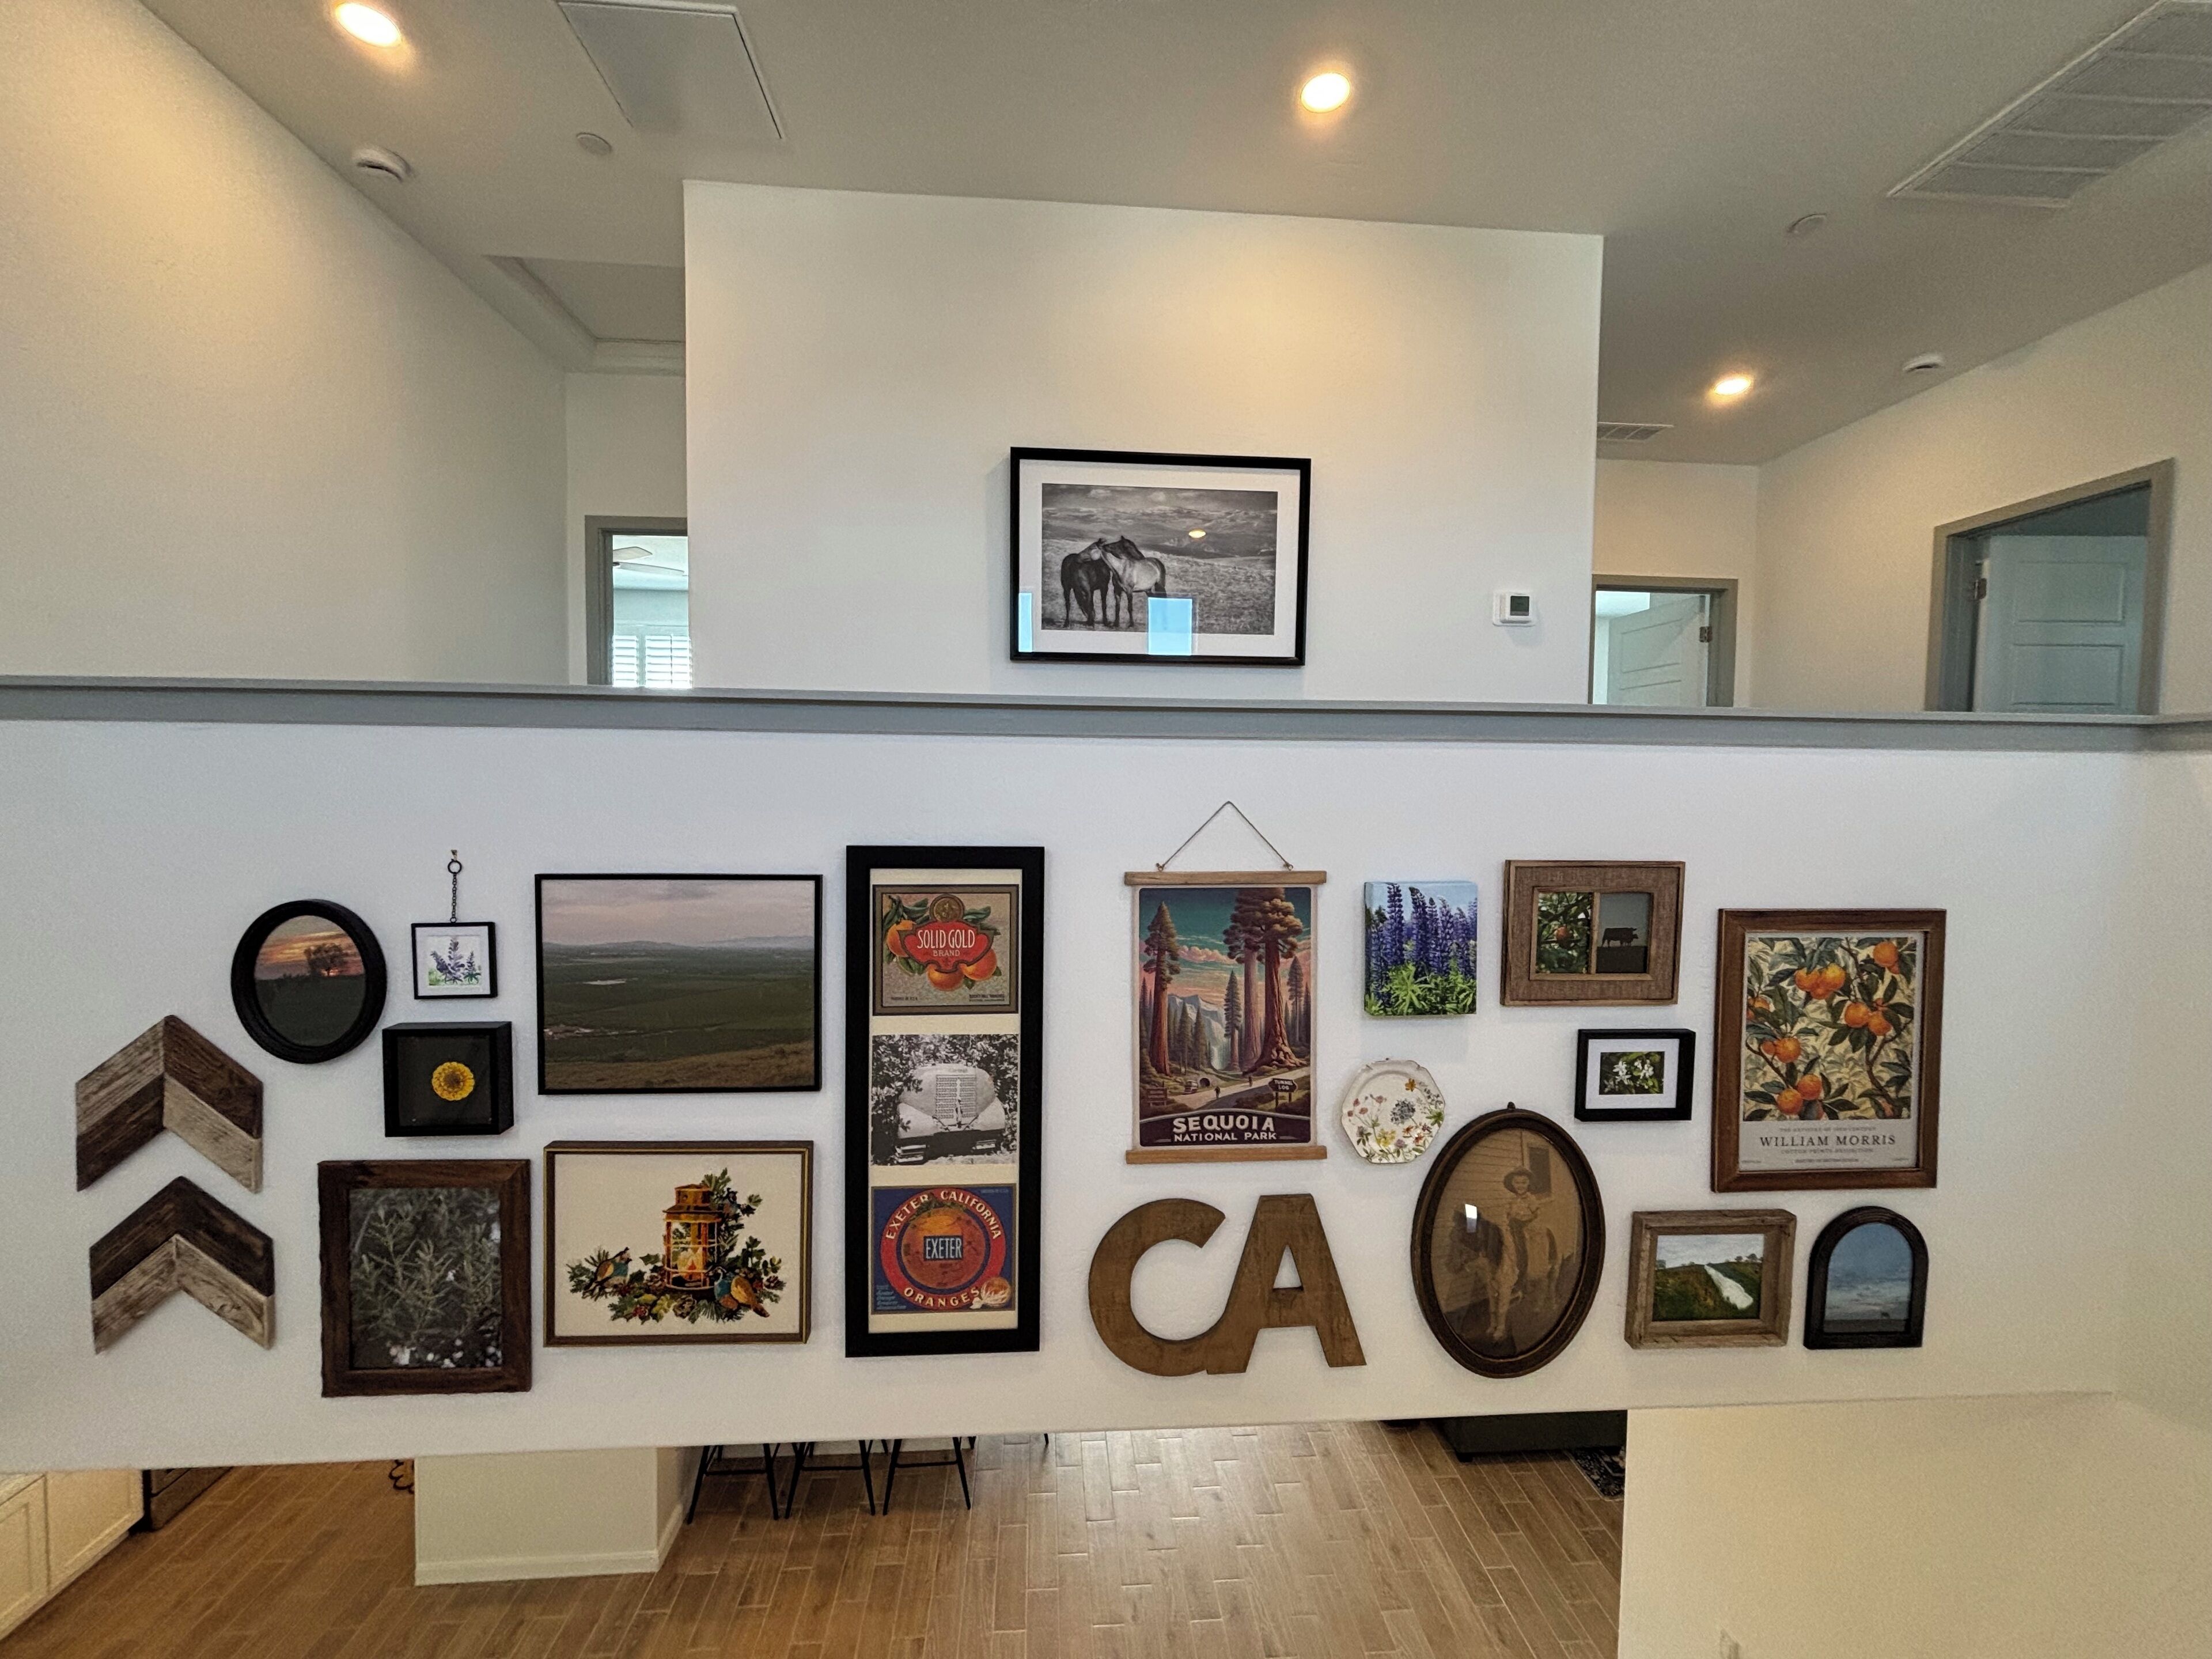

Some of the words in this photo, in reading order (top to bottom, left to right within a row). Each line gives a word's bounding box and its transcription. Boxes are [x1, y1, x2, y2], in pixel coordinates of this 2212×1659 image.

[917, 930, 946, 949] SOLID
[948, 929, 975, 949] GOLD
[1173, 1115, 1275, 1134] SEQUOIA
[1174, 1132, 1237, 1142] NATIONAL
[1244, 1131, 1278, 1141] PARK
[1760, 1136, 1828, 1147] WILLIAM
[1836, 1135, 1896, 1146] MORRIS
[886, 1194, 929, 1240] EXETER
[941, 1190, 1001, 1239] CALIFORNIA
[925, 1238, 962, 1259] EXETER
[1088, 1193, 1367, 1377] CA
[904, 1287, 979, 1307] ORANGES
